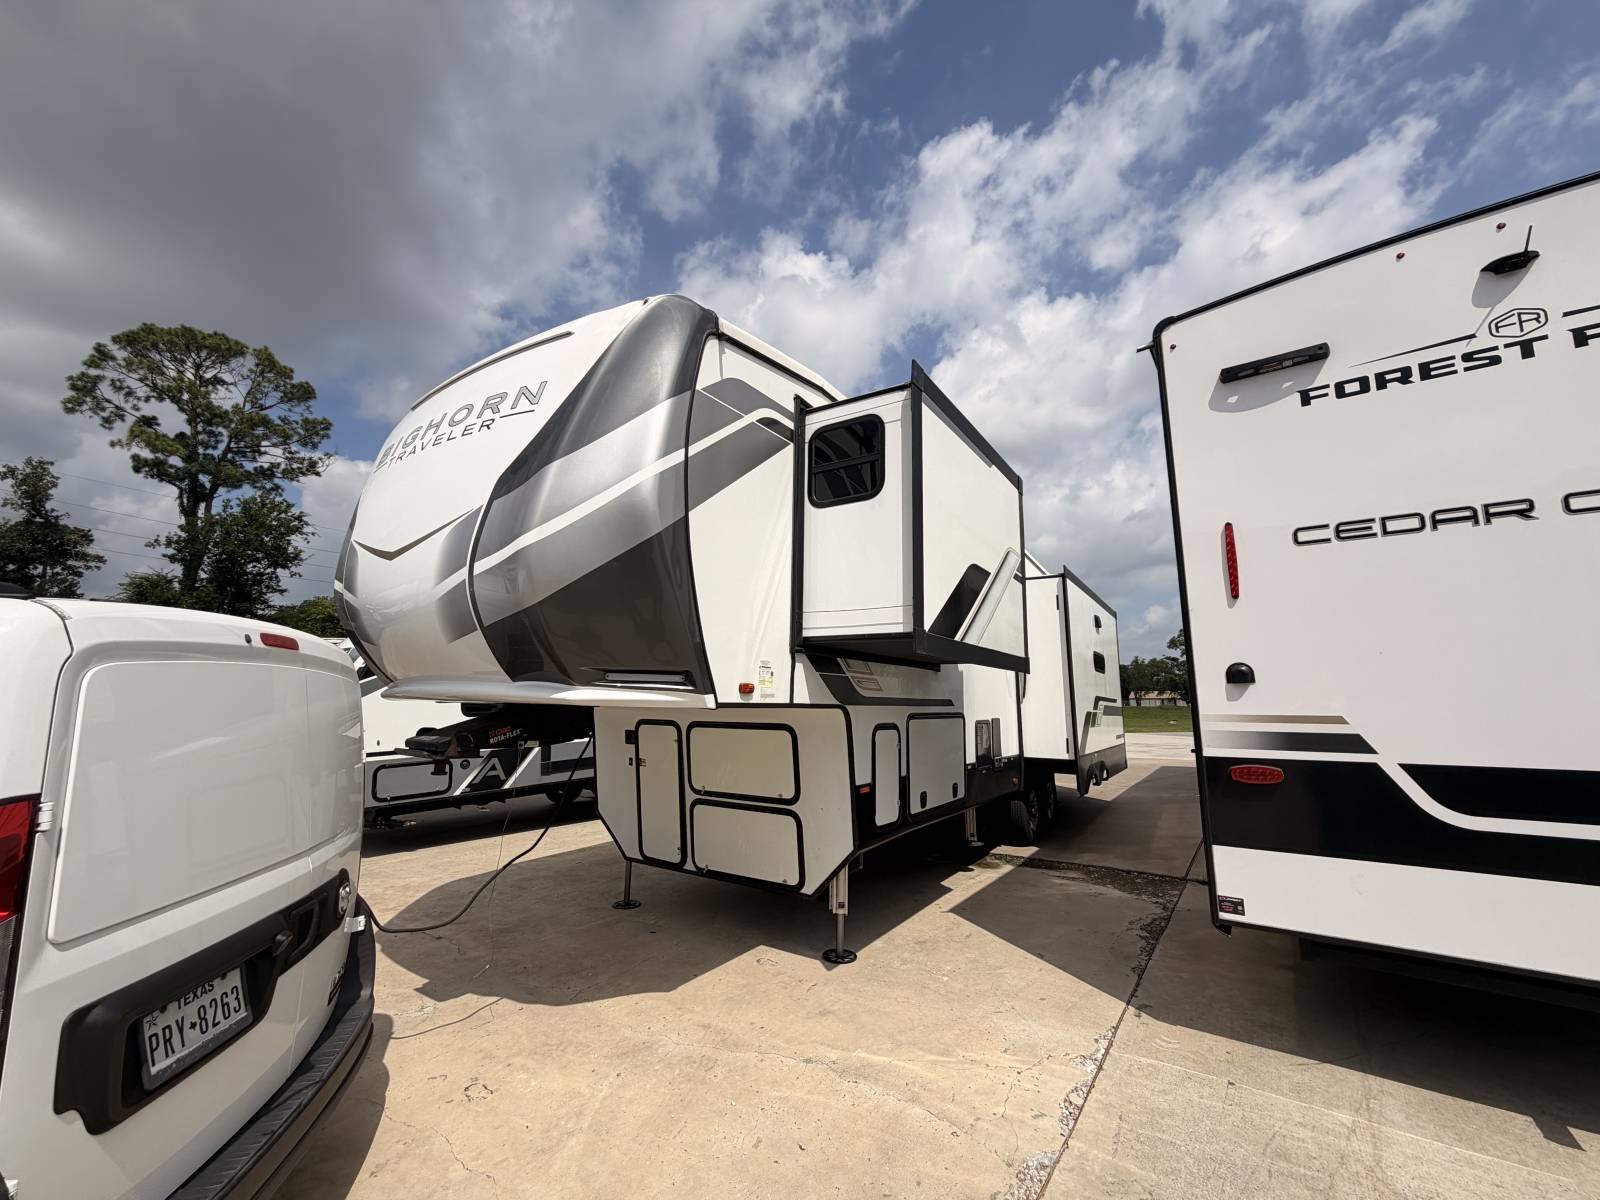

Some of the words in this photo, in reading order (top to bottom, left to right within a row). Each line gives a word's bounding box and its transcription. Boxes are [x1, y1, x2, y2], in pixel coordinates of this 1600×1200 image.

[1296, 333, 1549, 407] FOREST
[374, 380, 548, 469] BIGHORN
[387, 418, 496, 470] TRAVELER
[1292, 498, 1540, 547] CEDAR
[176, 980, 215, 1010] TEXAS
